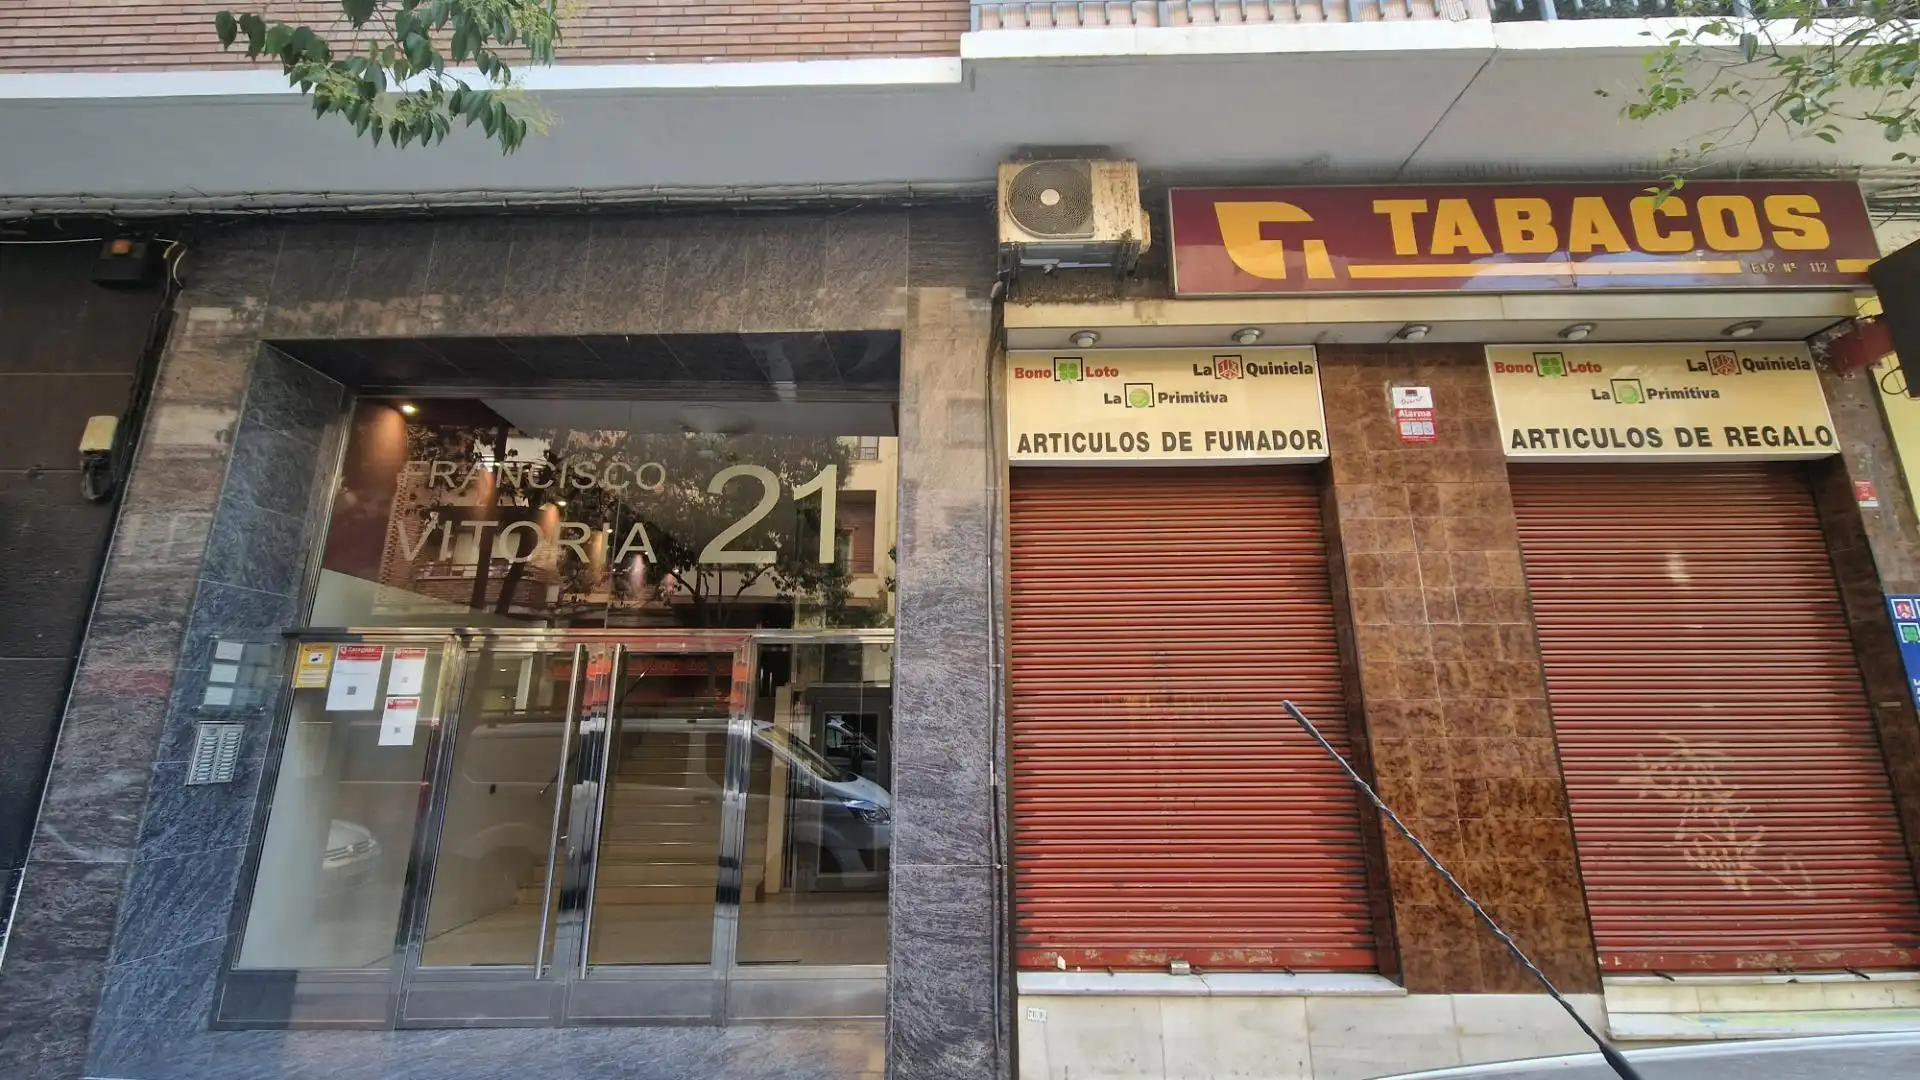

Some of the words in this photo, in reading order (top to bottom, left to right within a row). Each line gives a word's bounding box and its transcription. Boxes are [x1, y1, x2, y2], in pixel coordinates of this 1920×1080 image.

[1373, 195, 1830, 256] TABACOS
[1751, 262, 1775, 274] EXP
[1808, 262, 1830, 274] 112
[1014, 367, 1053, 379] Bono
[1085, 366, 1120, 378] Loto
[1192, 363, 1213, 377] La
[1246, 361, 1314, 378] Quiniela
[1494, 361, 1535, 374] Bono
[1567, 361, 1603, 373] Loto
[1686, 359, 1708, 372] La
[1741, 356, 1812, 373] Quiniela
[1103, 392, 1122, 405] La
[1157, 390, 1229, 404] Primitiva
[1591, 388, 1612, 401] La
[1646, 386, 1721, 400] Primitiva
[1398, 409, 1433, 418] Alarma
[1016, 431, 1151, 454] ARTICULOS
[1161, 431, 1193, 452] DE
[1204, 429, 1323, 452] FUMADOR
[1511, 427, 1664, 449] ARTICULOS
[1674, 426, 1713, 448] DE
[1723, 425, 1833, 448] REGALO
[404, 460, 666, 491] FRANCISCO
[699, 463, 839, 565] 21
[398, 519, 658, 564] VITORIA
